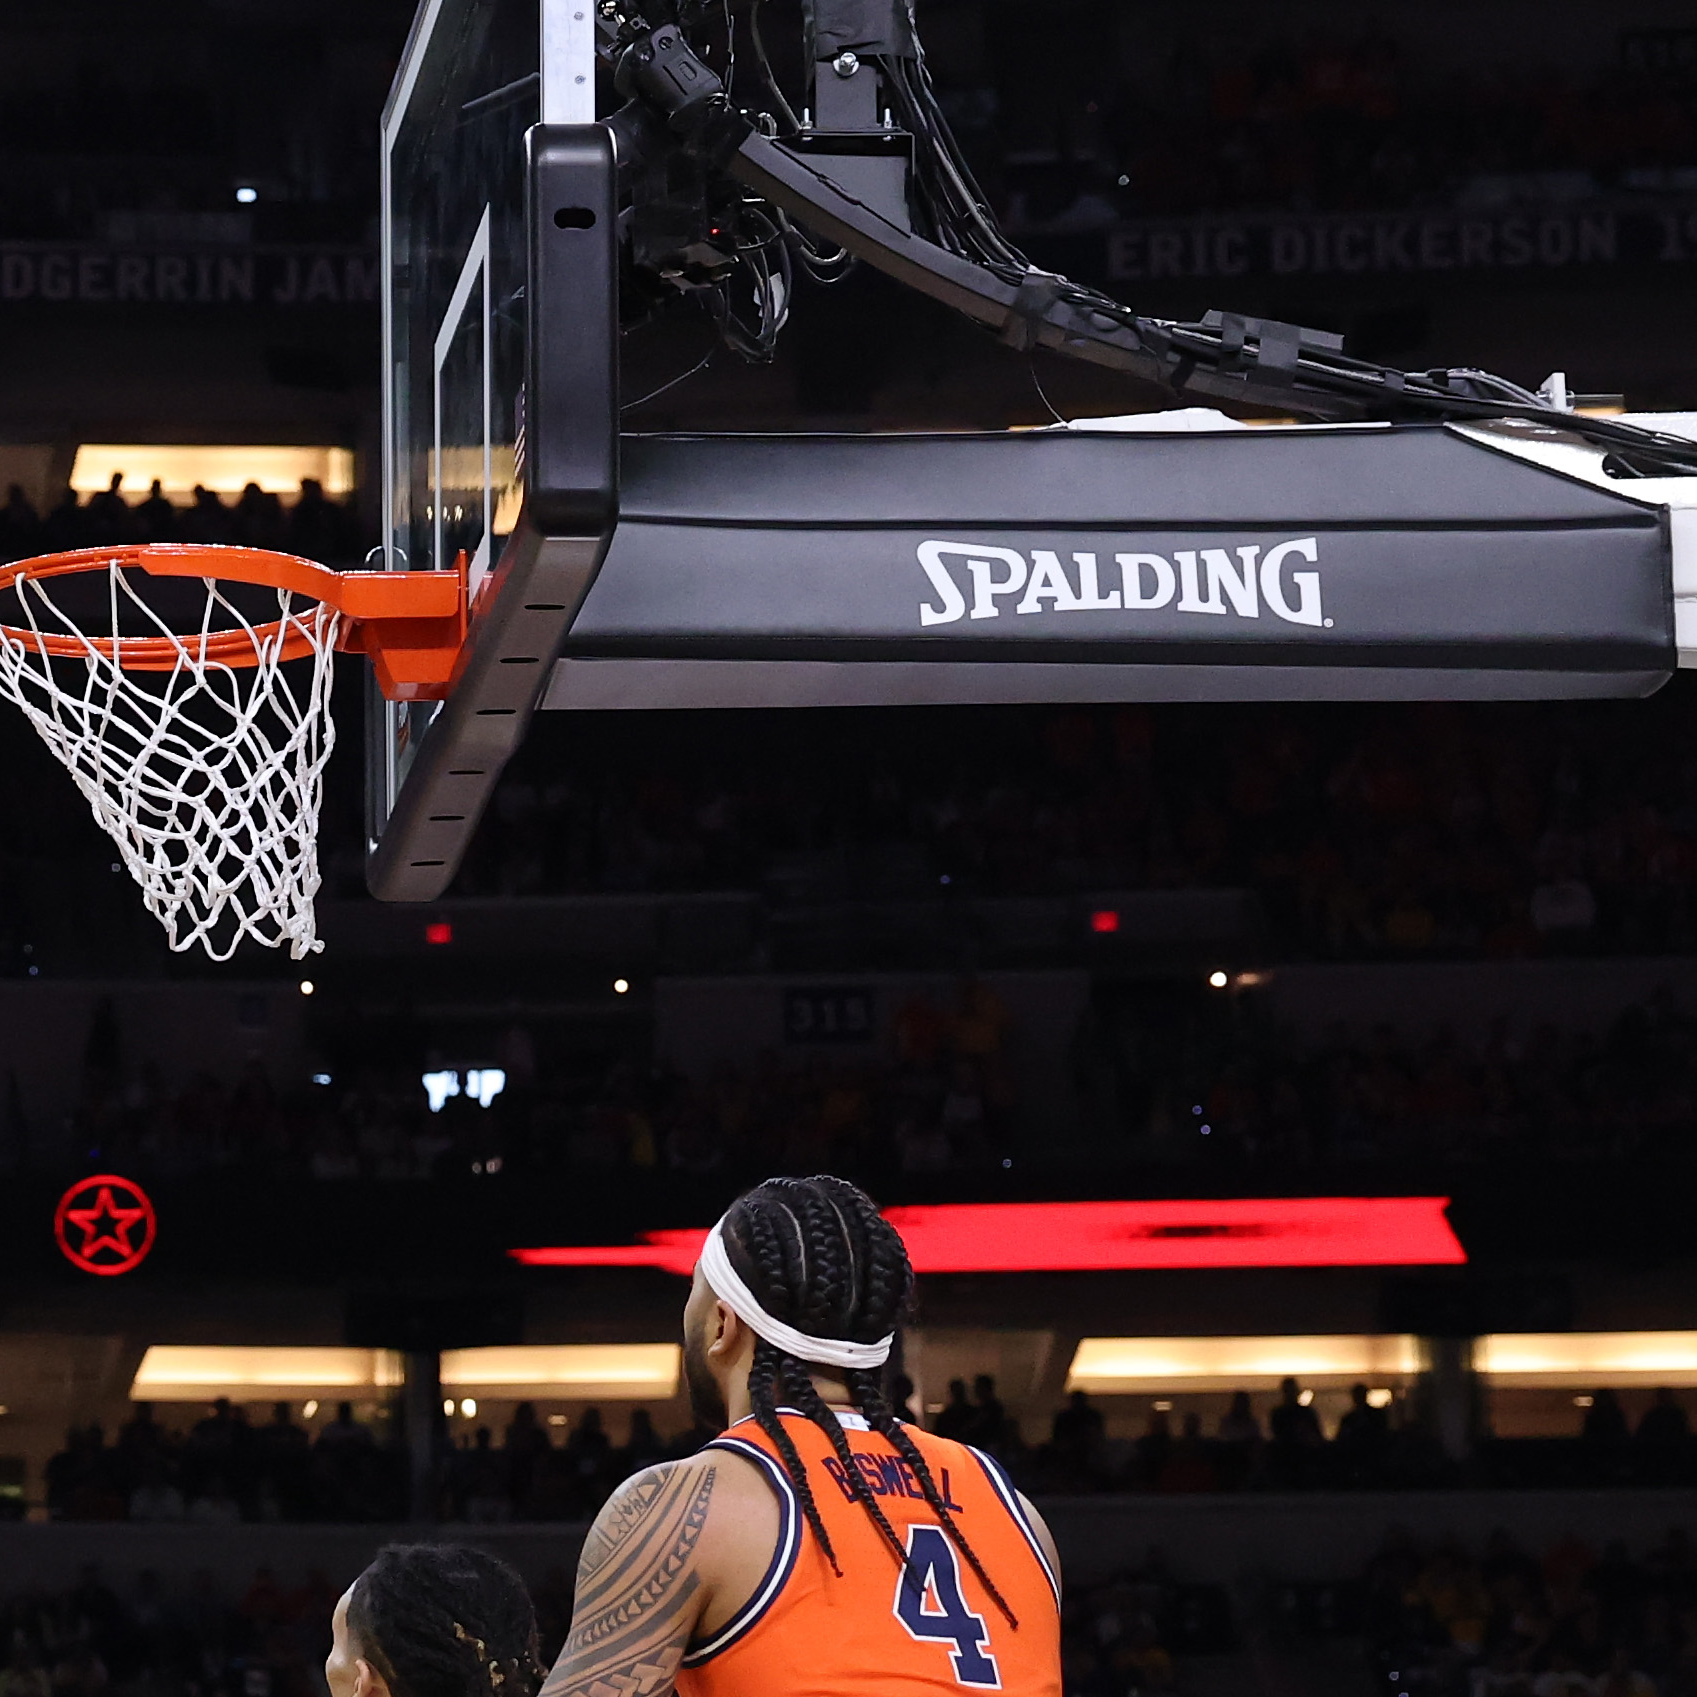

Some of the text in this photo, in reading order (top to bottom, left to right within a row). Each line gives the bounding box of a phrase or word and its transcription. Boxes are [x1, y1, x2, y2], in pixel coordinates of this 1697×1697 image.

[272, 254, 380, 302] JAM
[1109, 228, 1249, 281] ERIC
[1270, 212, 1619, 275] DICKERSON
[916, 536, 1333, 628] SPALDING
[821, 1453, 963, 1514] BSWEL
[892, 1524, 1003, 1690] 4
